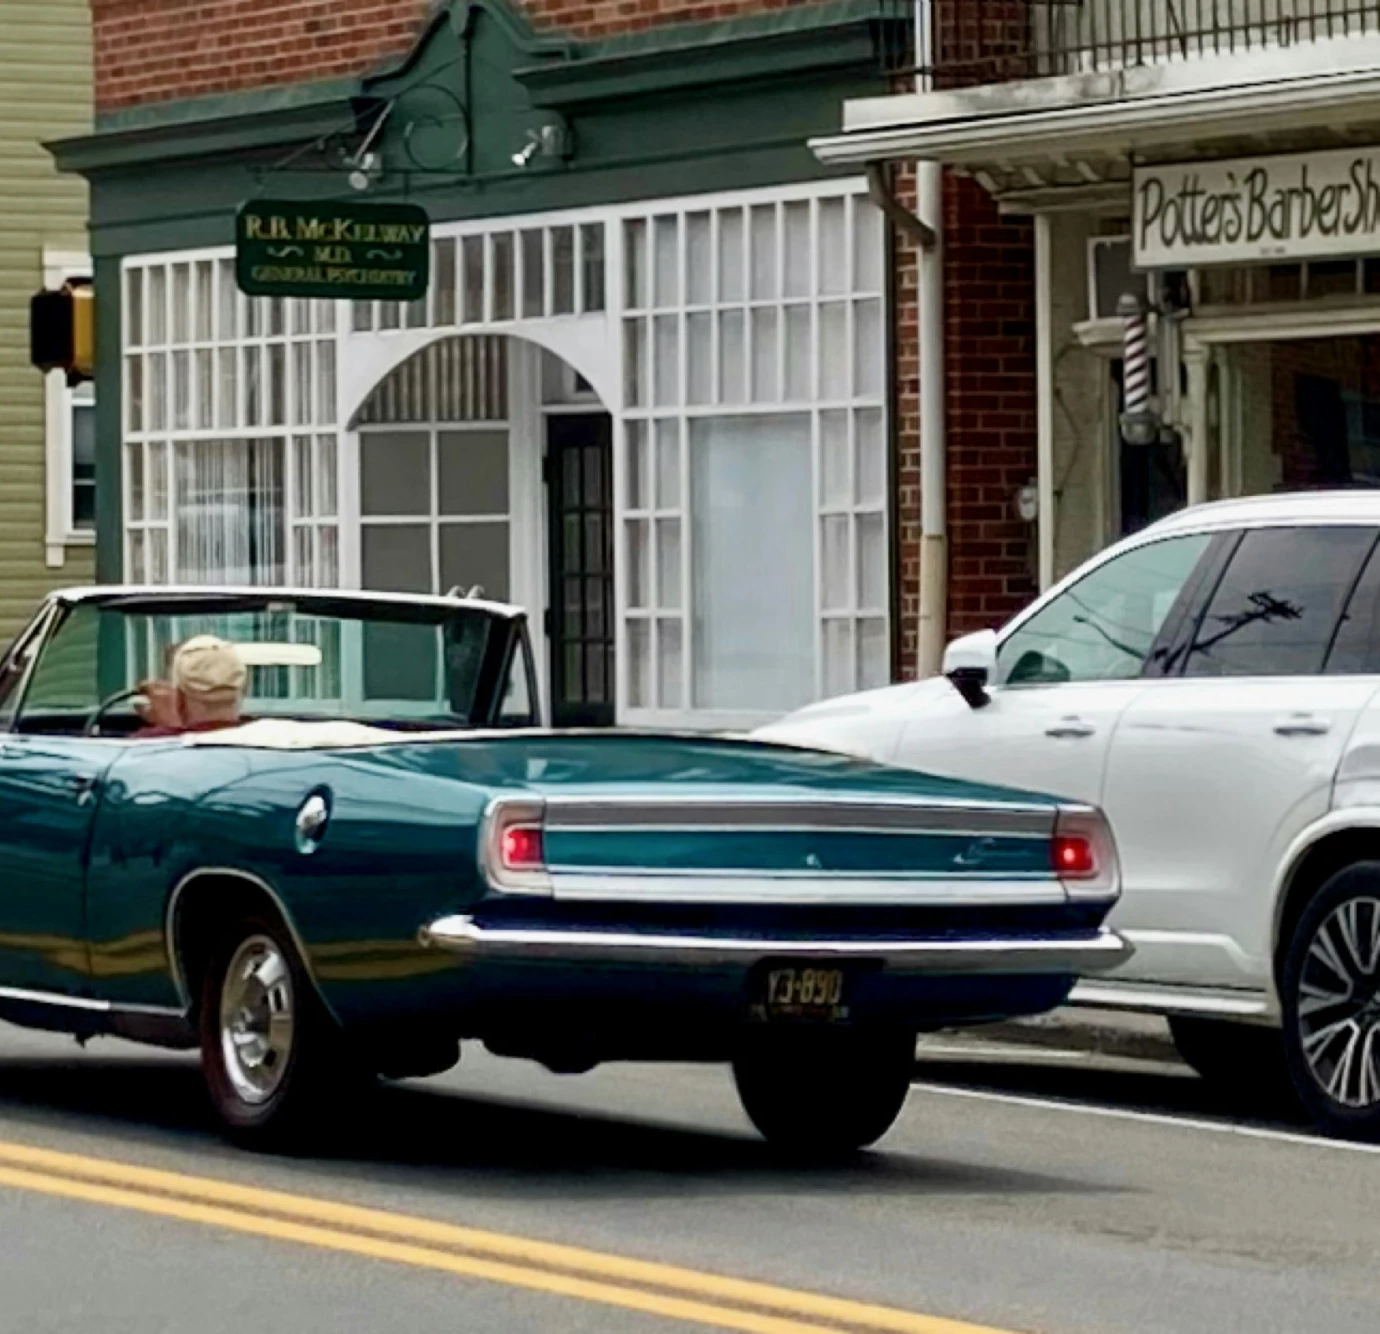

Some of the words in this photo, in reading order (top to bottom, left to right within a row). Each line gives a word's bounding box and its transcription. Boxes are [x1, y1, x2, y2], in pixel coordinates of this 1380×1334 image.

[1139, 170, 1242, 251] Potter's
[1244, 163, 1351, 242] Barber
[1343, 156, 1380, 235] Sh
